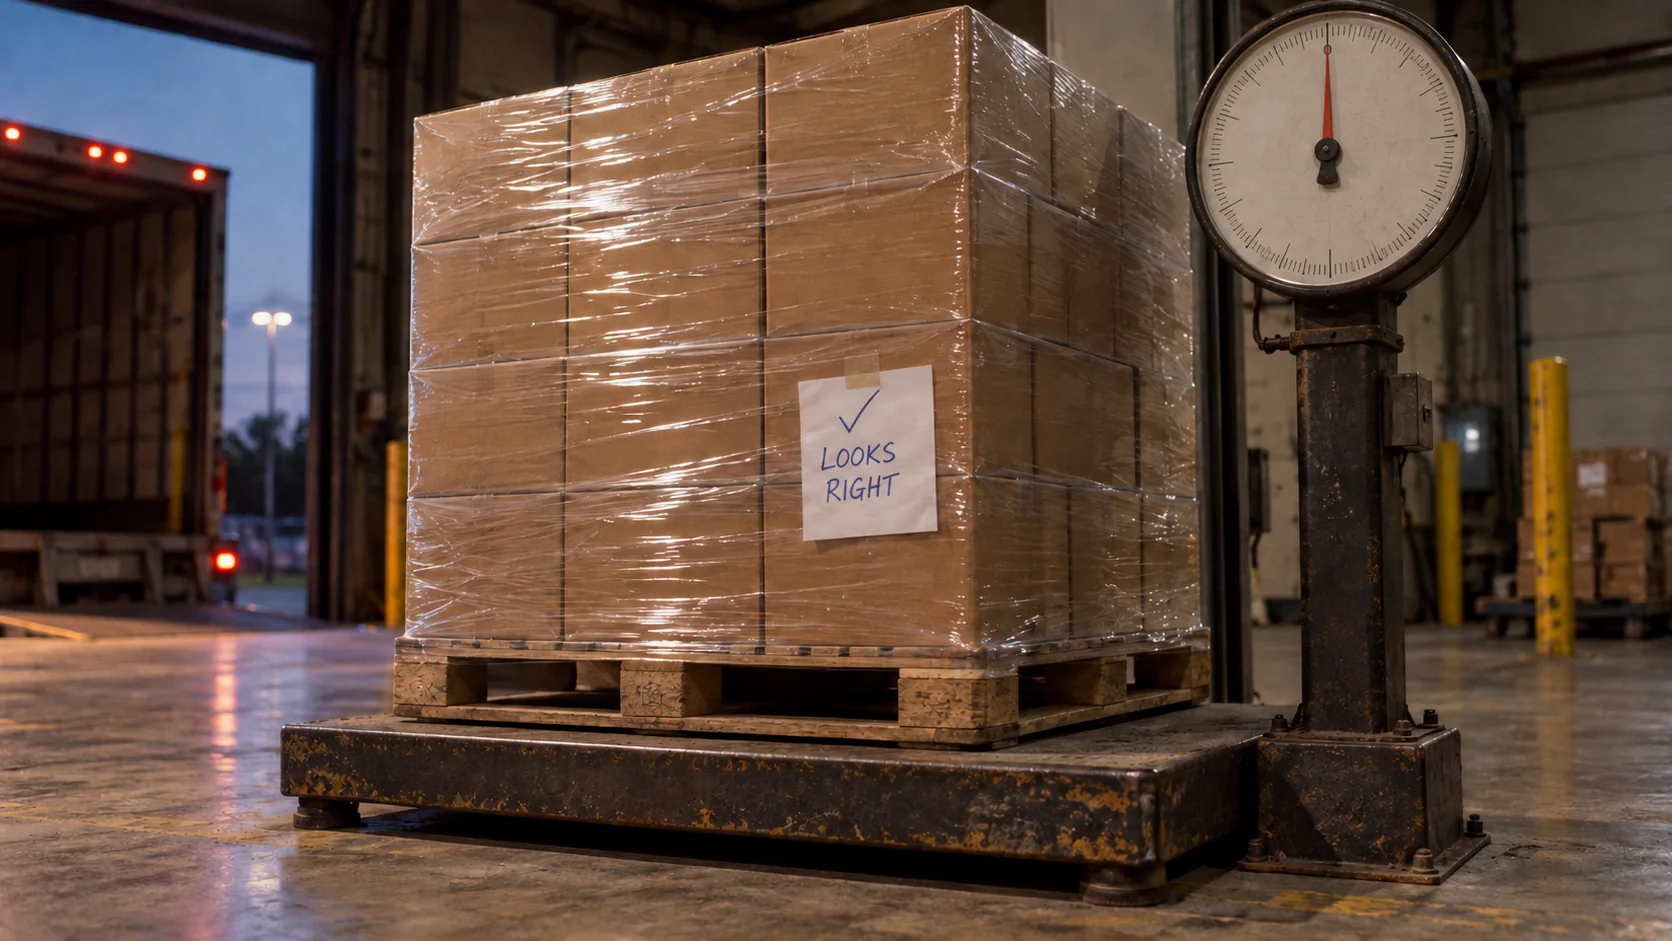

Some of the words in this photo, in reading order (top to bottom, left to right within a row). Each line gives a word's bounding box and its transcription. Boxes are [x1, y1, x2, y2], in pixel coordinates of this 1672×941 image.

[1323, 44, 1332, 55] 0
[821, 441, 896, 471] LOOKS
[826, 472, 900, 503] RIGHT
